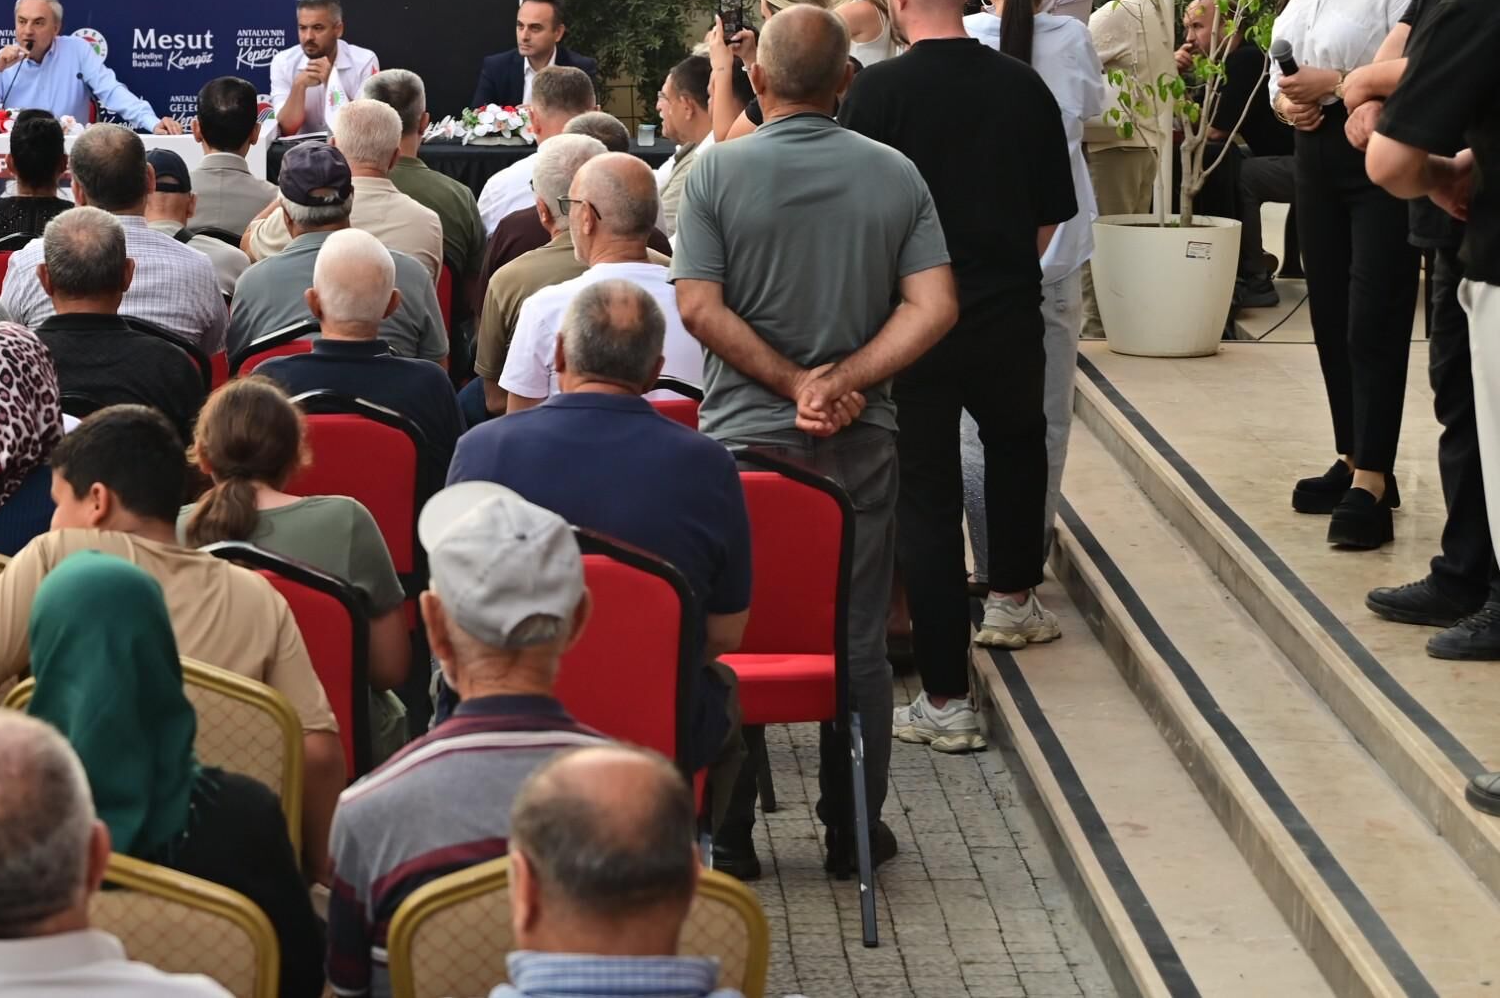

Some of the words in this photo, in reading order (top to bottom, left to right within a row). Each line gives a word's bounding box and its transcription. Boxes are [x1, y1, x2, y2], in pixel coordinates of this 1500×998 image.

[132, 28, 214, 49] Mesut
[132, 52, 163, 62] Belediye
[167, 50, 214, 71] Kocagöz
[132, 60, 163, 69] Başkanı
